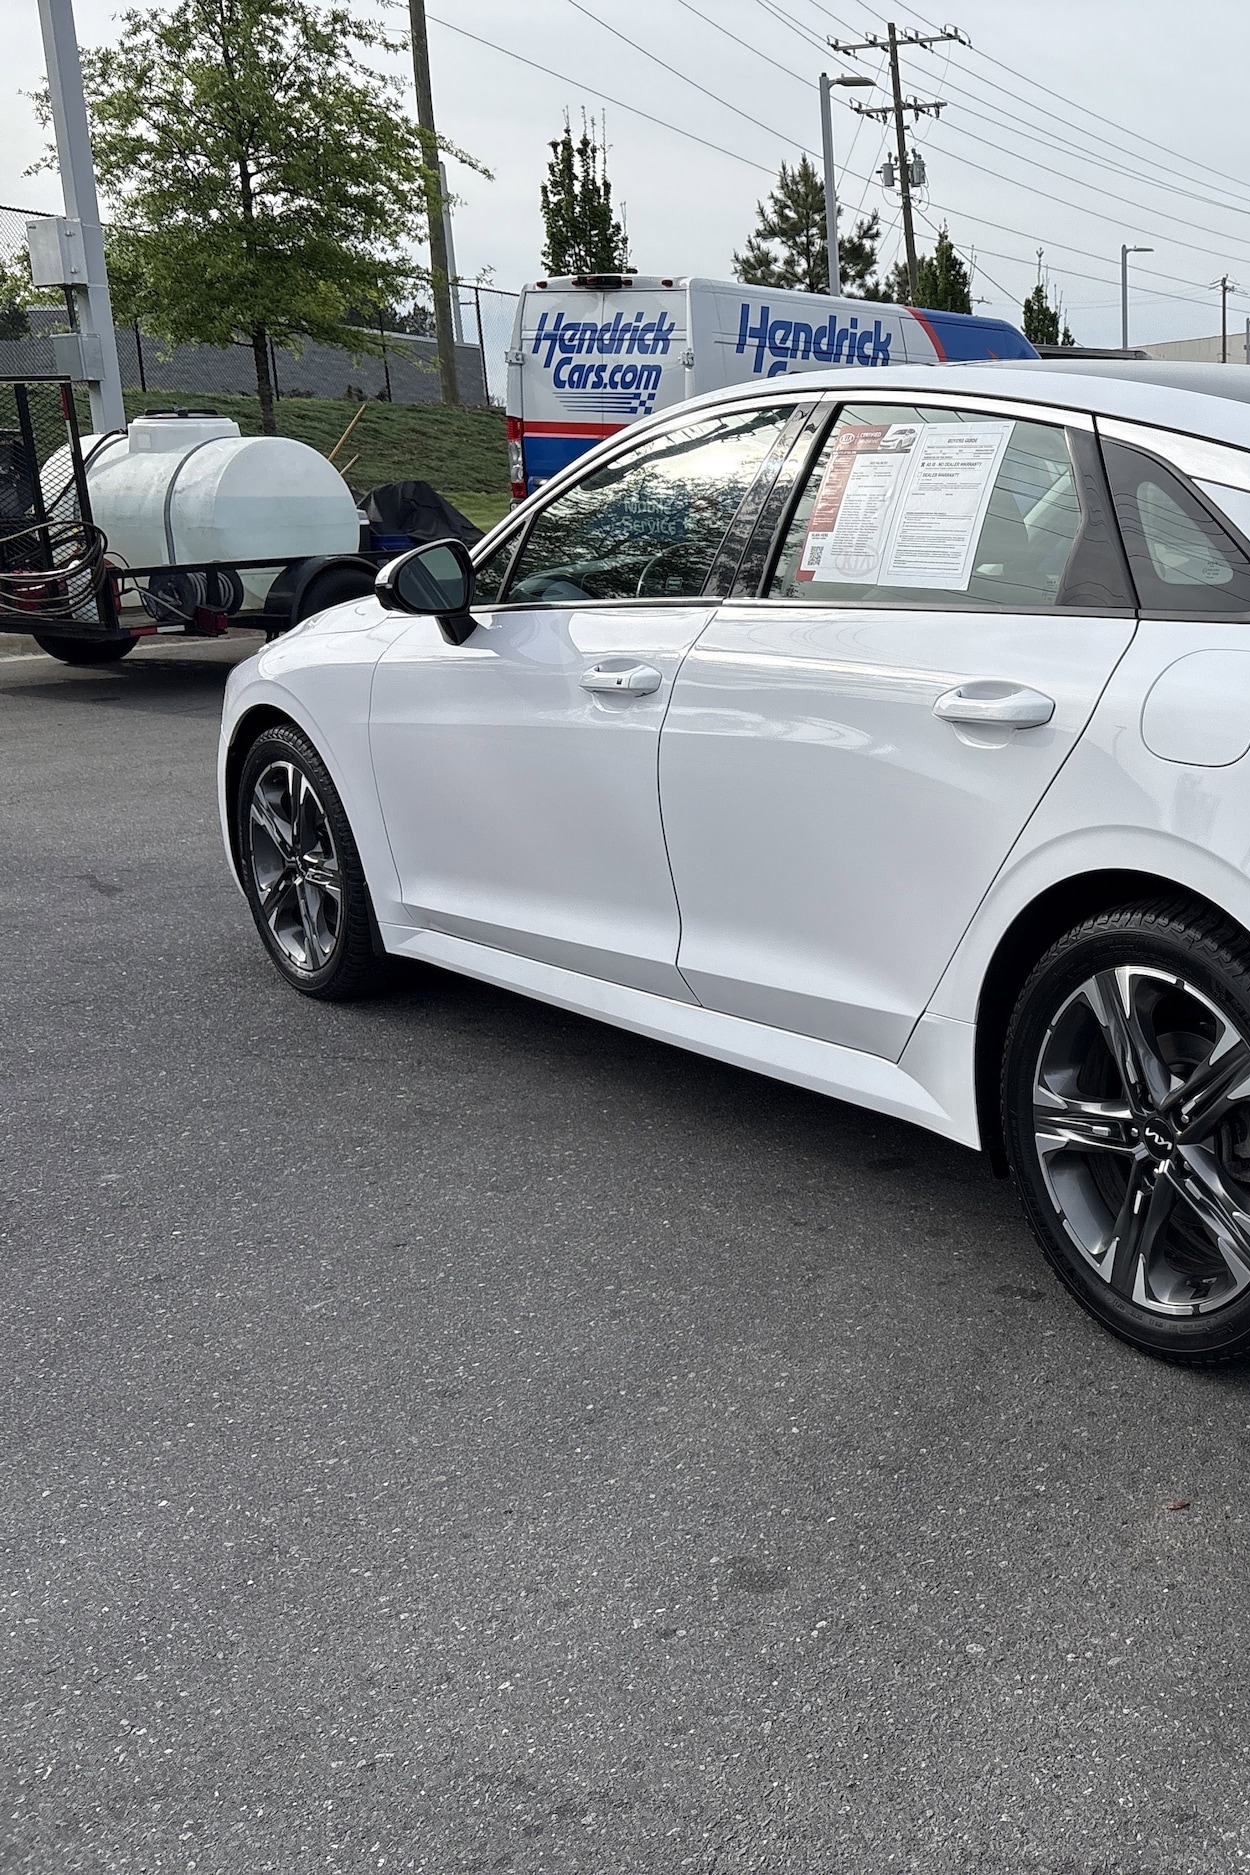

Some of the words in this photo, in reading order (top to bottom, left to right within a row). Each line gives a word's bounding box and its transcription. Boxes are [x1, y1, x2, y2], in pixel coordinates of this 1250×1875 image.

[532, 312, 675, 368] Hendrick
[736, 304, 892, 374] Hendrick
[553, 357, 663, 390] Cars.com
